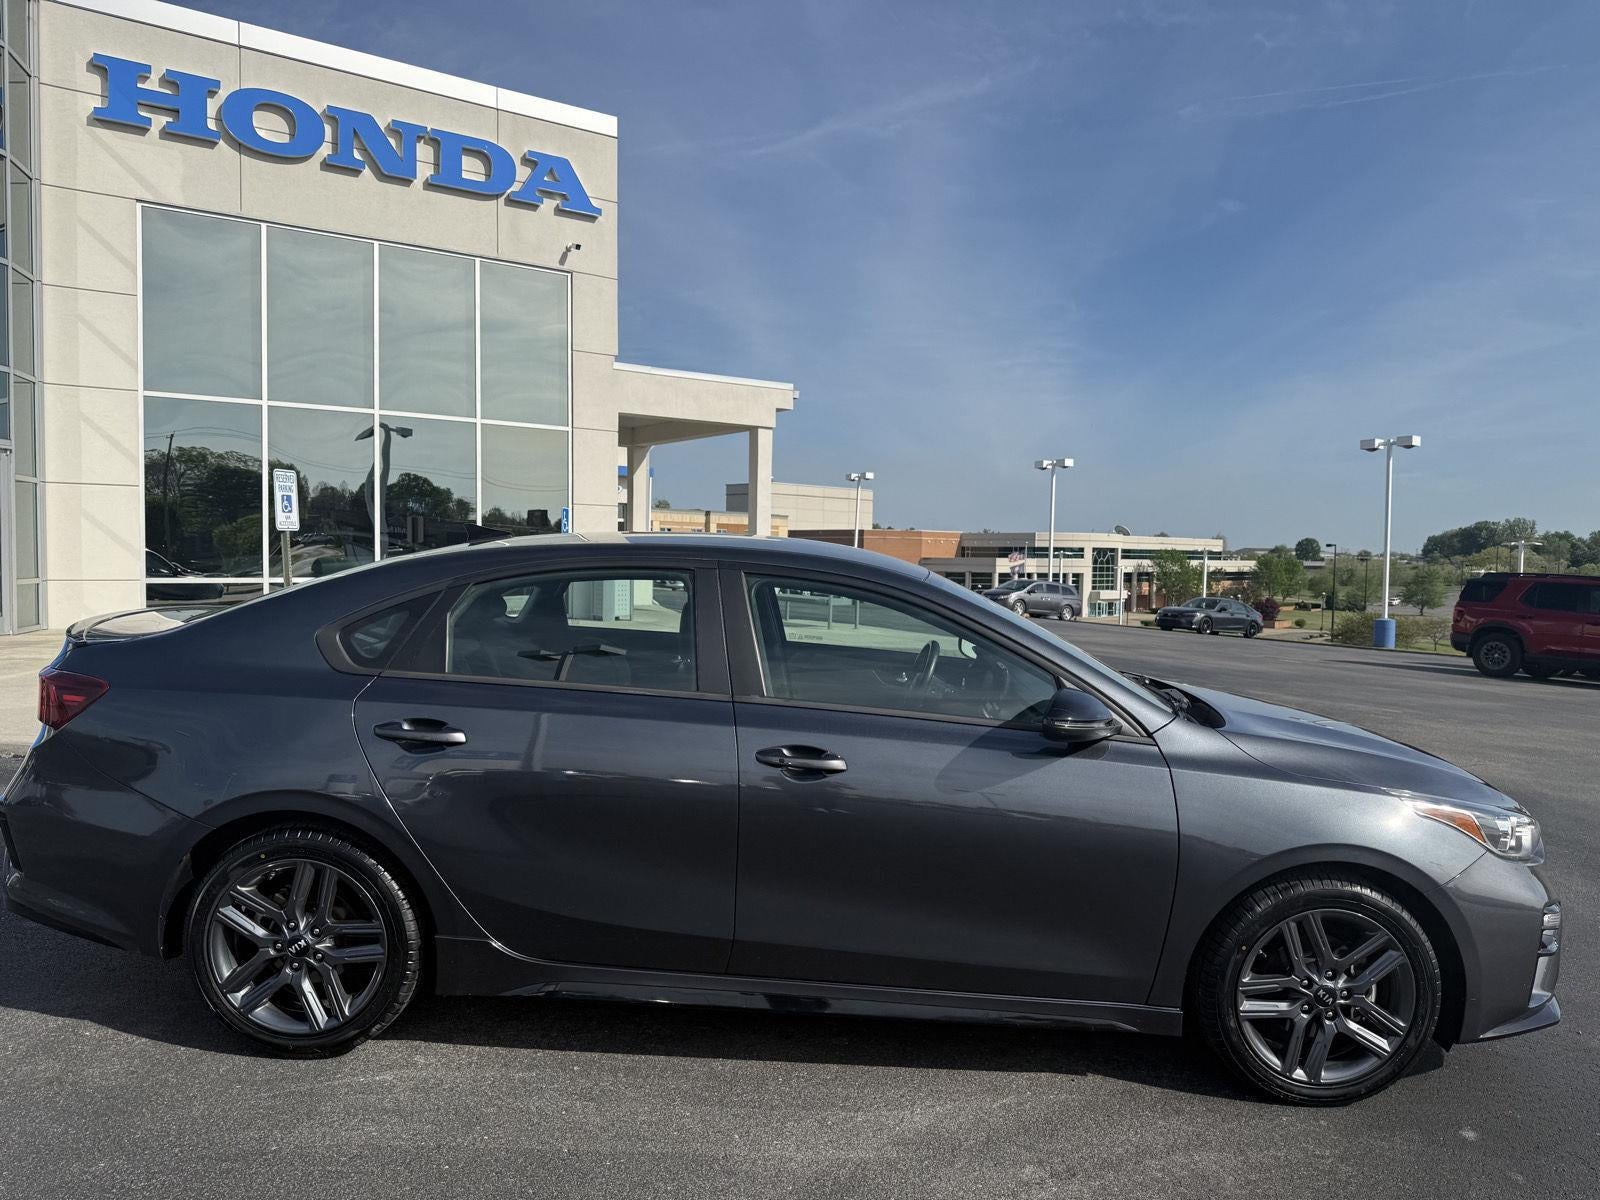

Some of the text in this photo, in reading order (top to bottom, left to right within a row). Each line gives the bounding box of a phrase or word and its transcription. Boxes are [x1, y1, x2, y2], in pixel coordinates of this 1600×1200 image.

[92, 53, 603, 217] HONDA
[288, 939, 307, 954] KIA
[1317, 989, 1333, 1005] KIA
